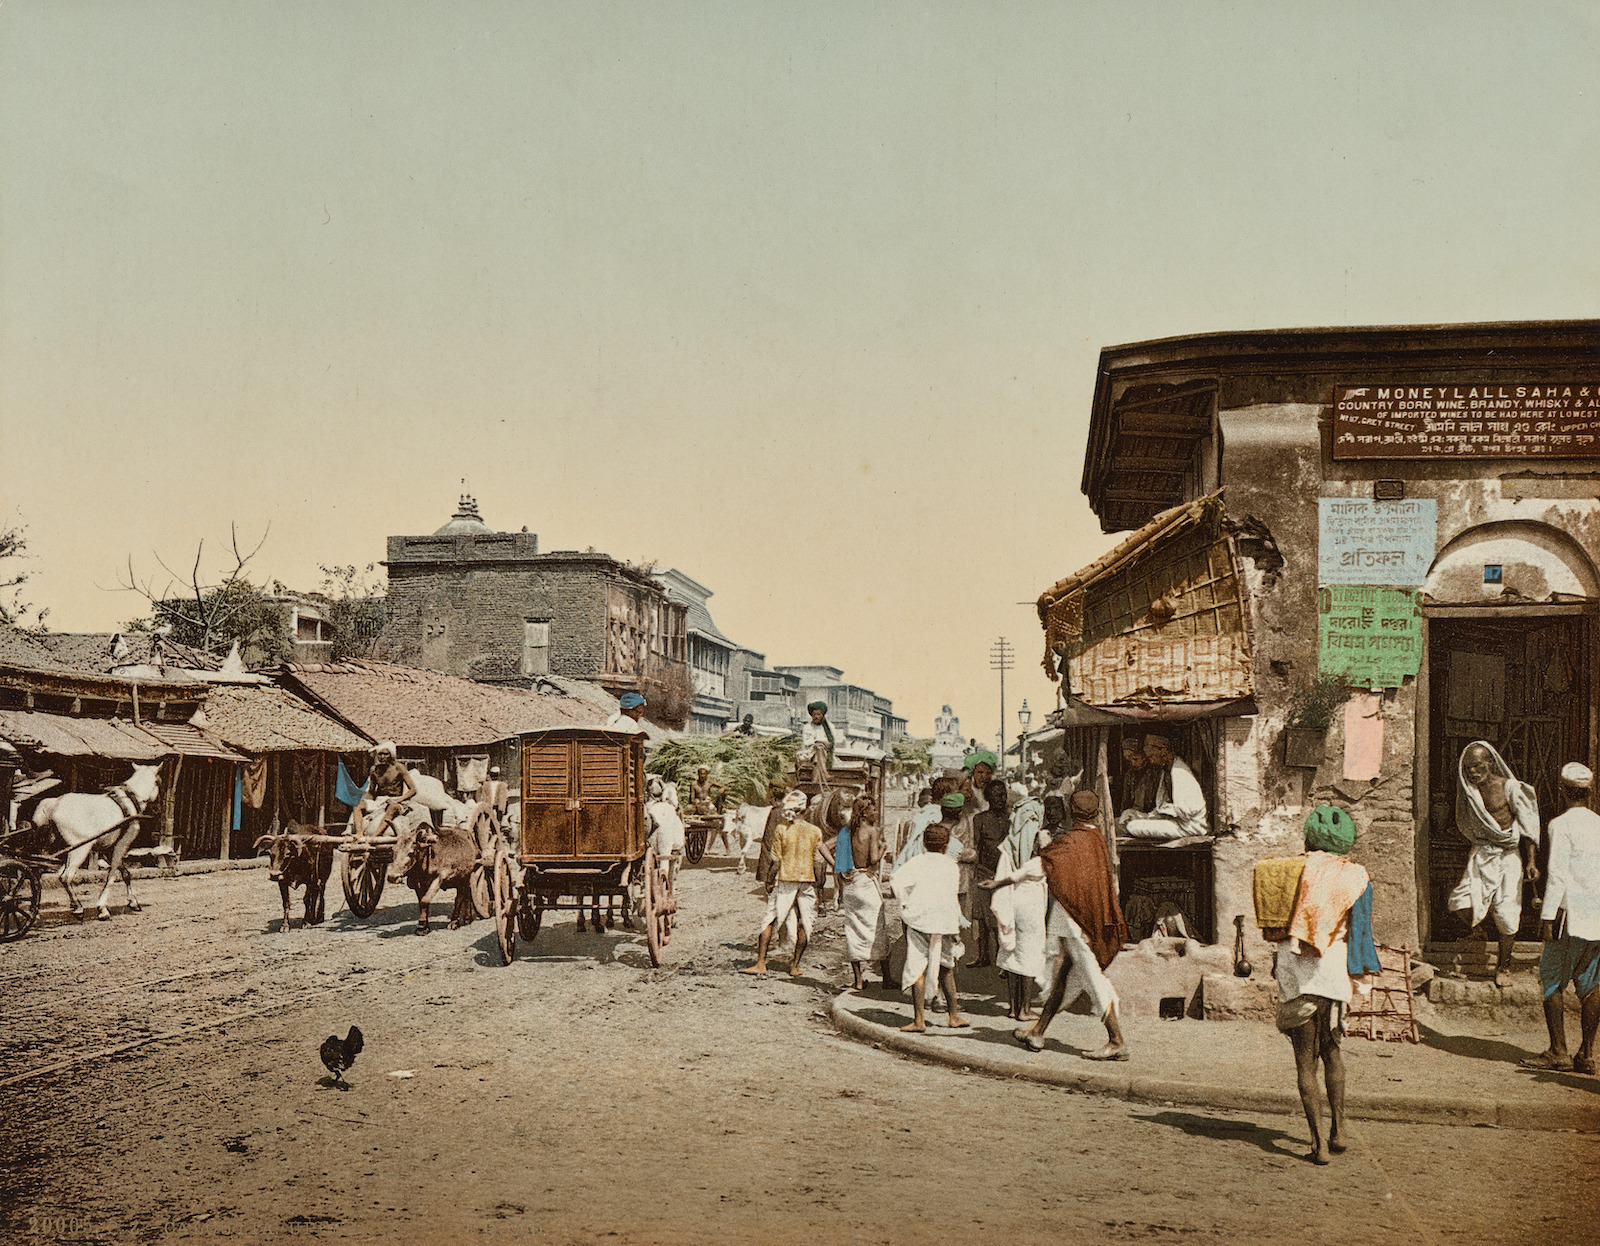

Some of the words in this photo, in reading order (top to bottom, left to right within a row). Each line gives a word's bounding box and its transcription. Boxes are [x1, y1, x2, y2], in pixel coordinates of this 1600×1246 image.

[1516, 386, 1572, 398] SAHA
[1580, 386, 1590, 397] &
[1338, 401, 1394, 410] COUNTRY
[1399, 400, 1432, 410] BORN
[1526, 399, 1570, 408] WHISKY
[1574, 400, 1583, 408] &
[1377, 411, 1388, 419] OF
[1391, 411, 1437, 419] IMPORTED
[1361, 417, 1383, 427] GREY
[1385, 421, 1416, 432] STREET
[1459, 421, 1483, 432] লাল
[1561, 423, 1588, 433] UPPER
